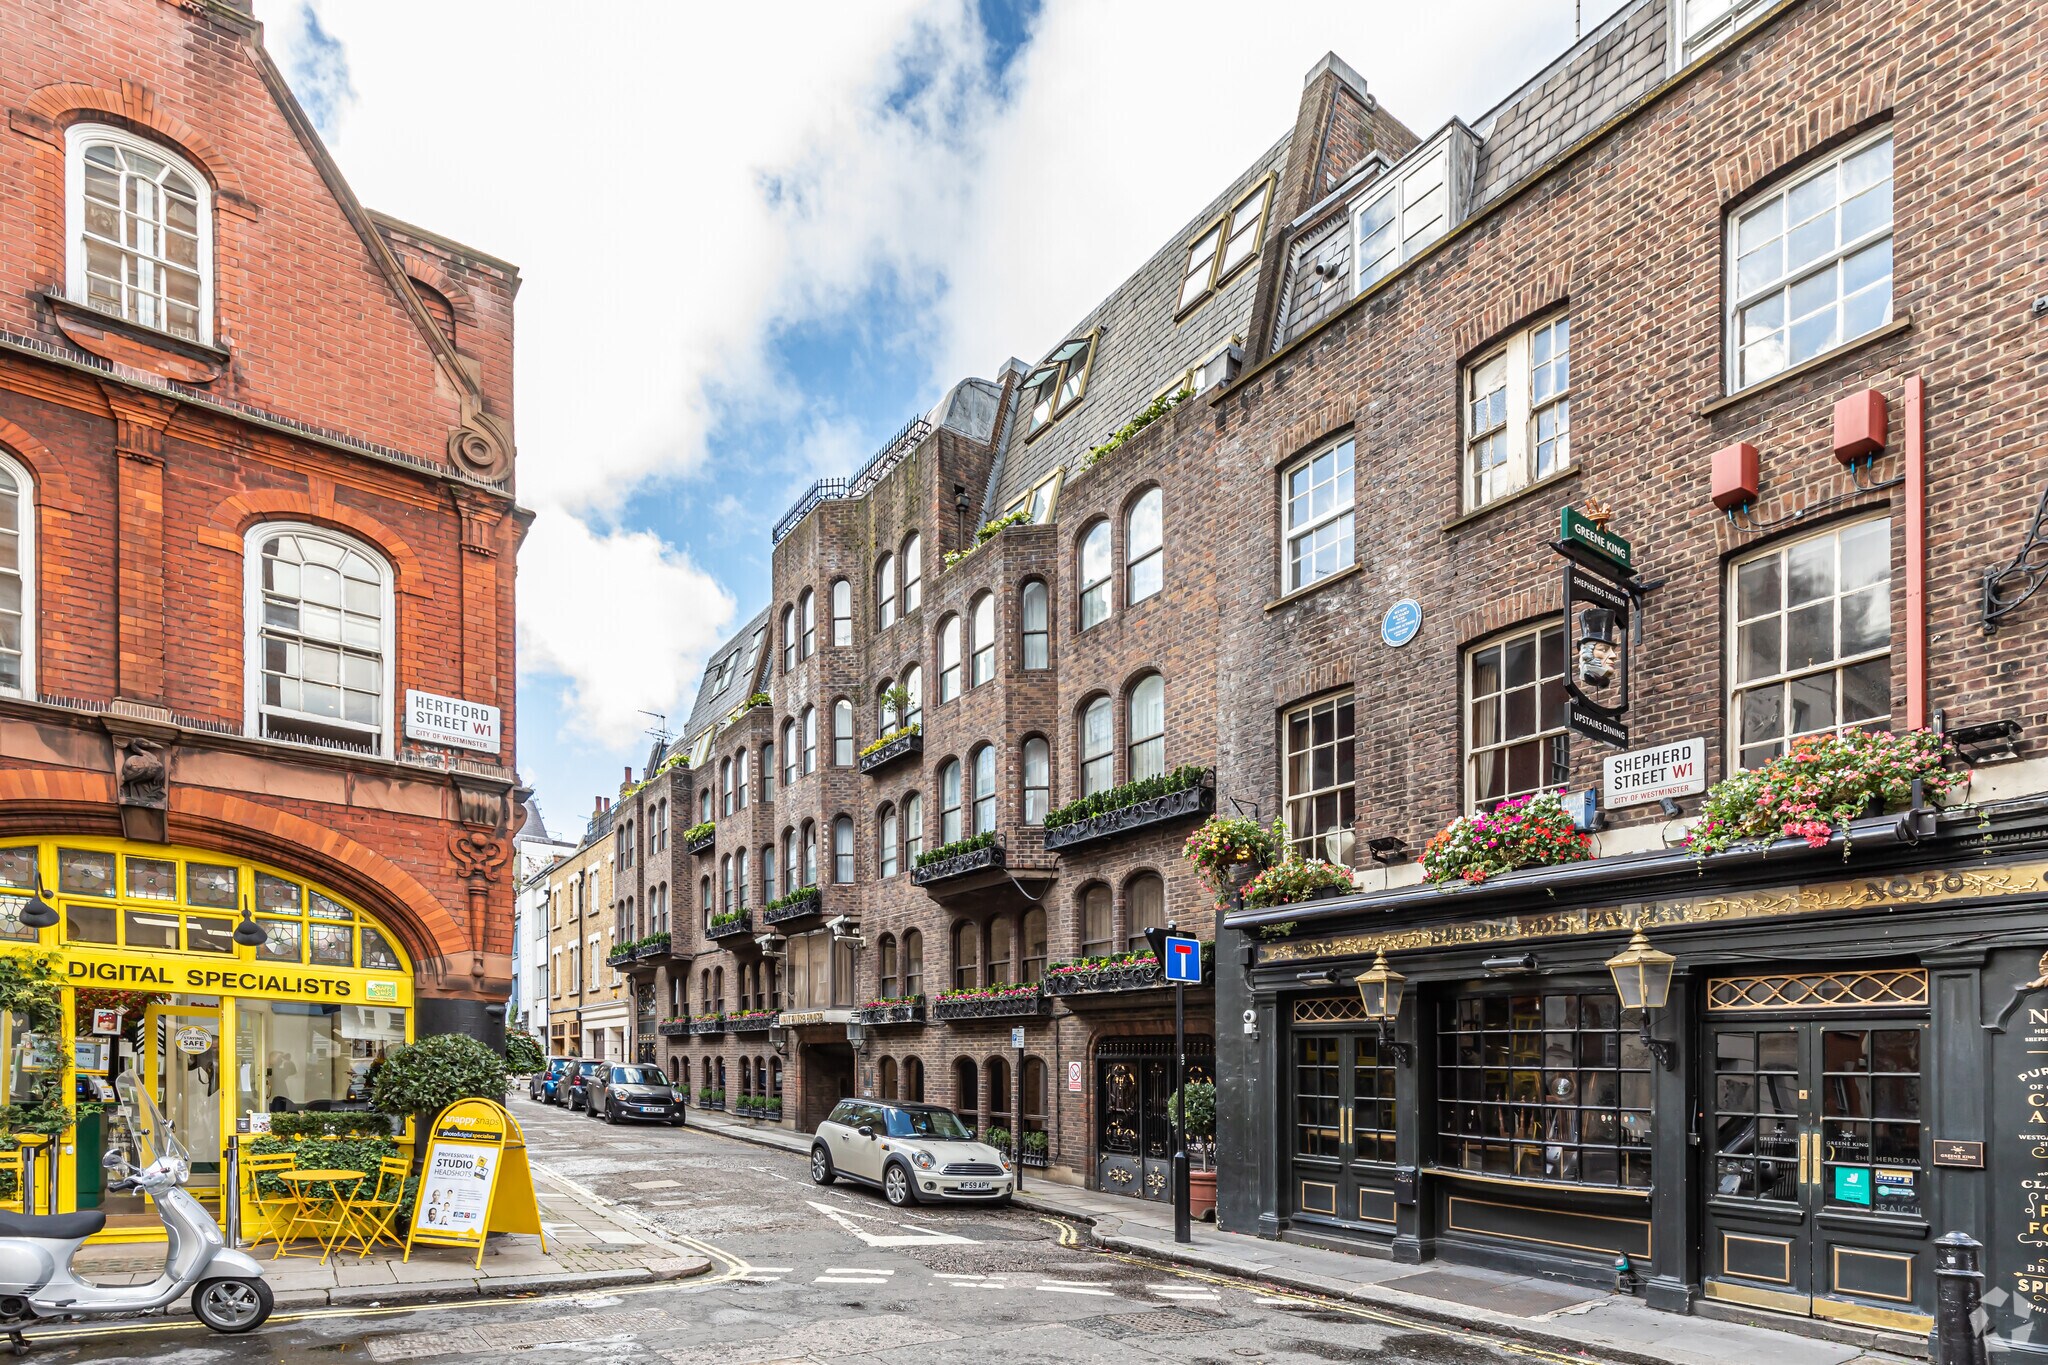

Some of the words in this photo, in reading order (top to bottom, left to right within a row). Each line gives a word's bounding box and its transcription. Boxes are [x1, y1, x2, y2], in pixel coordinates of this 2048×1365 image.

[1574, 523, 1605, 548] GREENE
[1606, 541, 1626, 559] KING
[1573, 576, 1605, 597] SHEPHERDS
[1605, 591, 1626, 607] TAVERN
[415, 695, 489, 722] HERTFORD
[416, 711, 468, 732] STREET
[472, 722, 491, 737] W1
[1573, 711, 1602, 731] UPSTAIRS
[1602, 723, 1626, 740] DINING
[415, 729, 431, 739] CITY
[442, 735, 488, 749] WESTMINSTER
[1614, 745, 1692, 774] SHEPHERD
[1614, 767, 1668, 790] STREET
[1672, 762, 1693, 779] W1
[1614, 796, 1629, 805] CITY
[1630, 793, 1639, 801] OF
[1640, 784, 1690, 799] WESTMINSTER
[67, 961, 174, 985] DIGITAL
[186, 969, 352, 996] SPECIALISTS
[436, 1158, 474, 1169] STUDIO
[438, 1151, 475, 1159] PROFESSIONAL
[434, 1168, 472, 1177] HEADSHOTS
[960, 1181, 977, 1189] WF59
[978, 1181, 990, 1189] APY
[2021, 1179, 2048, 1189] CL
